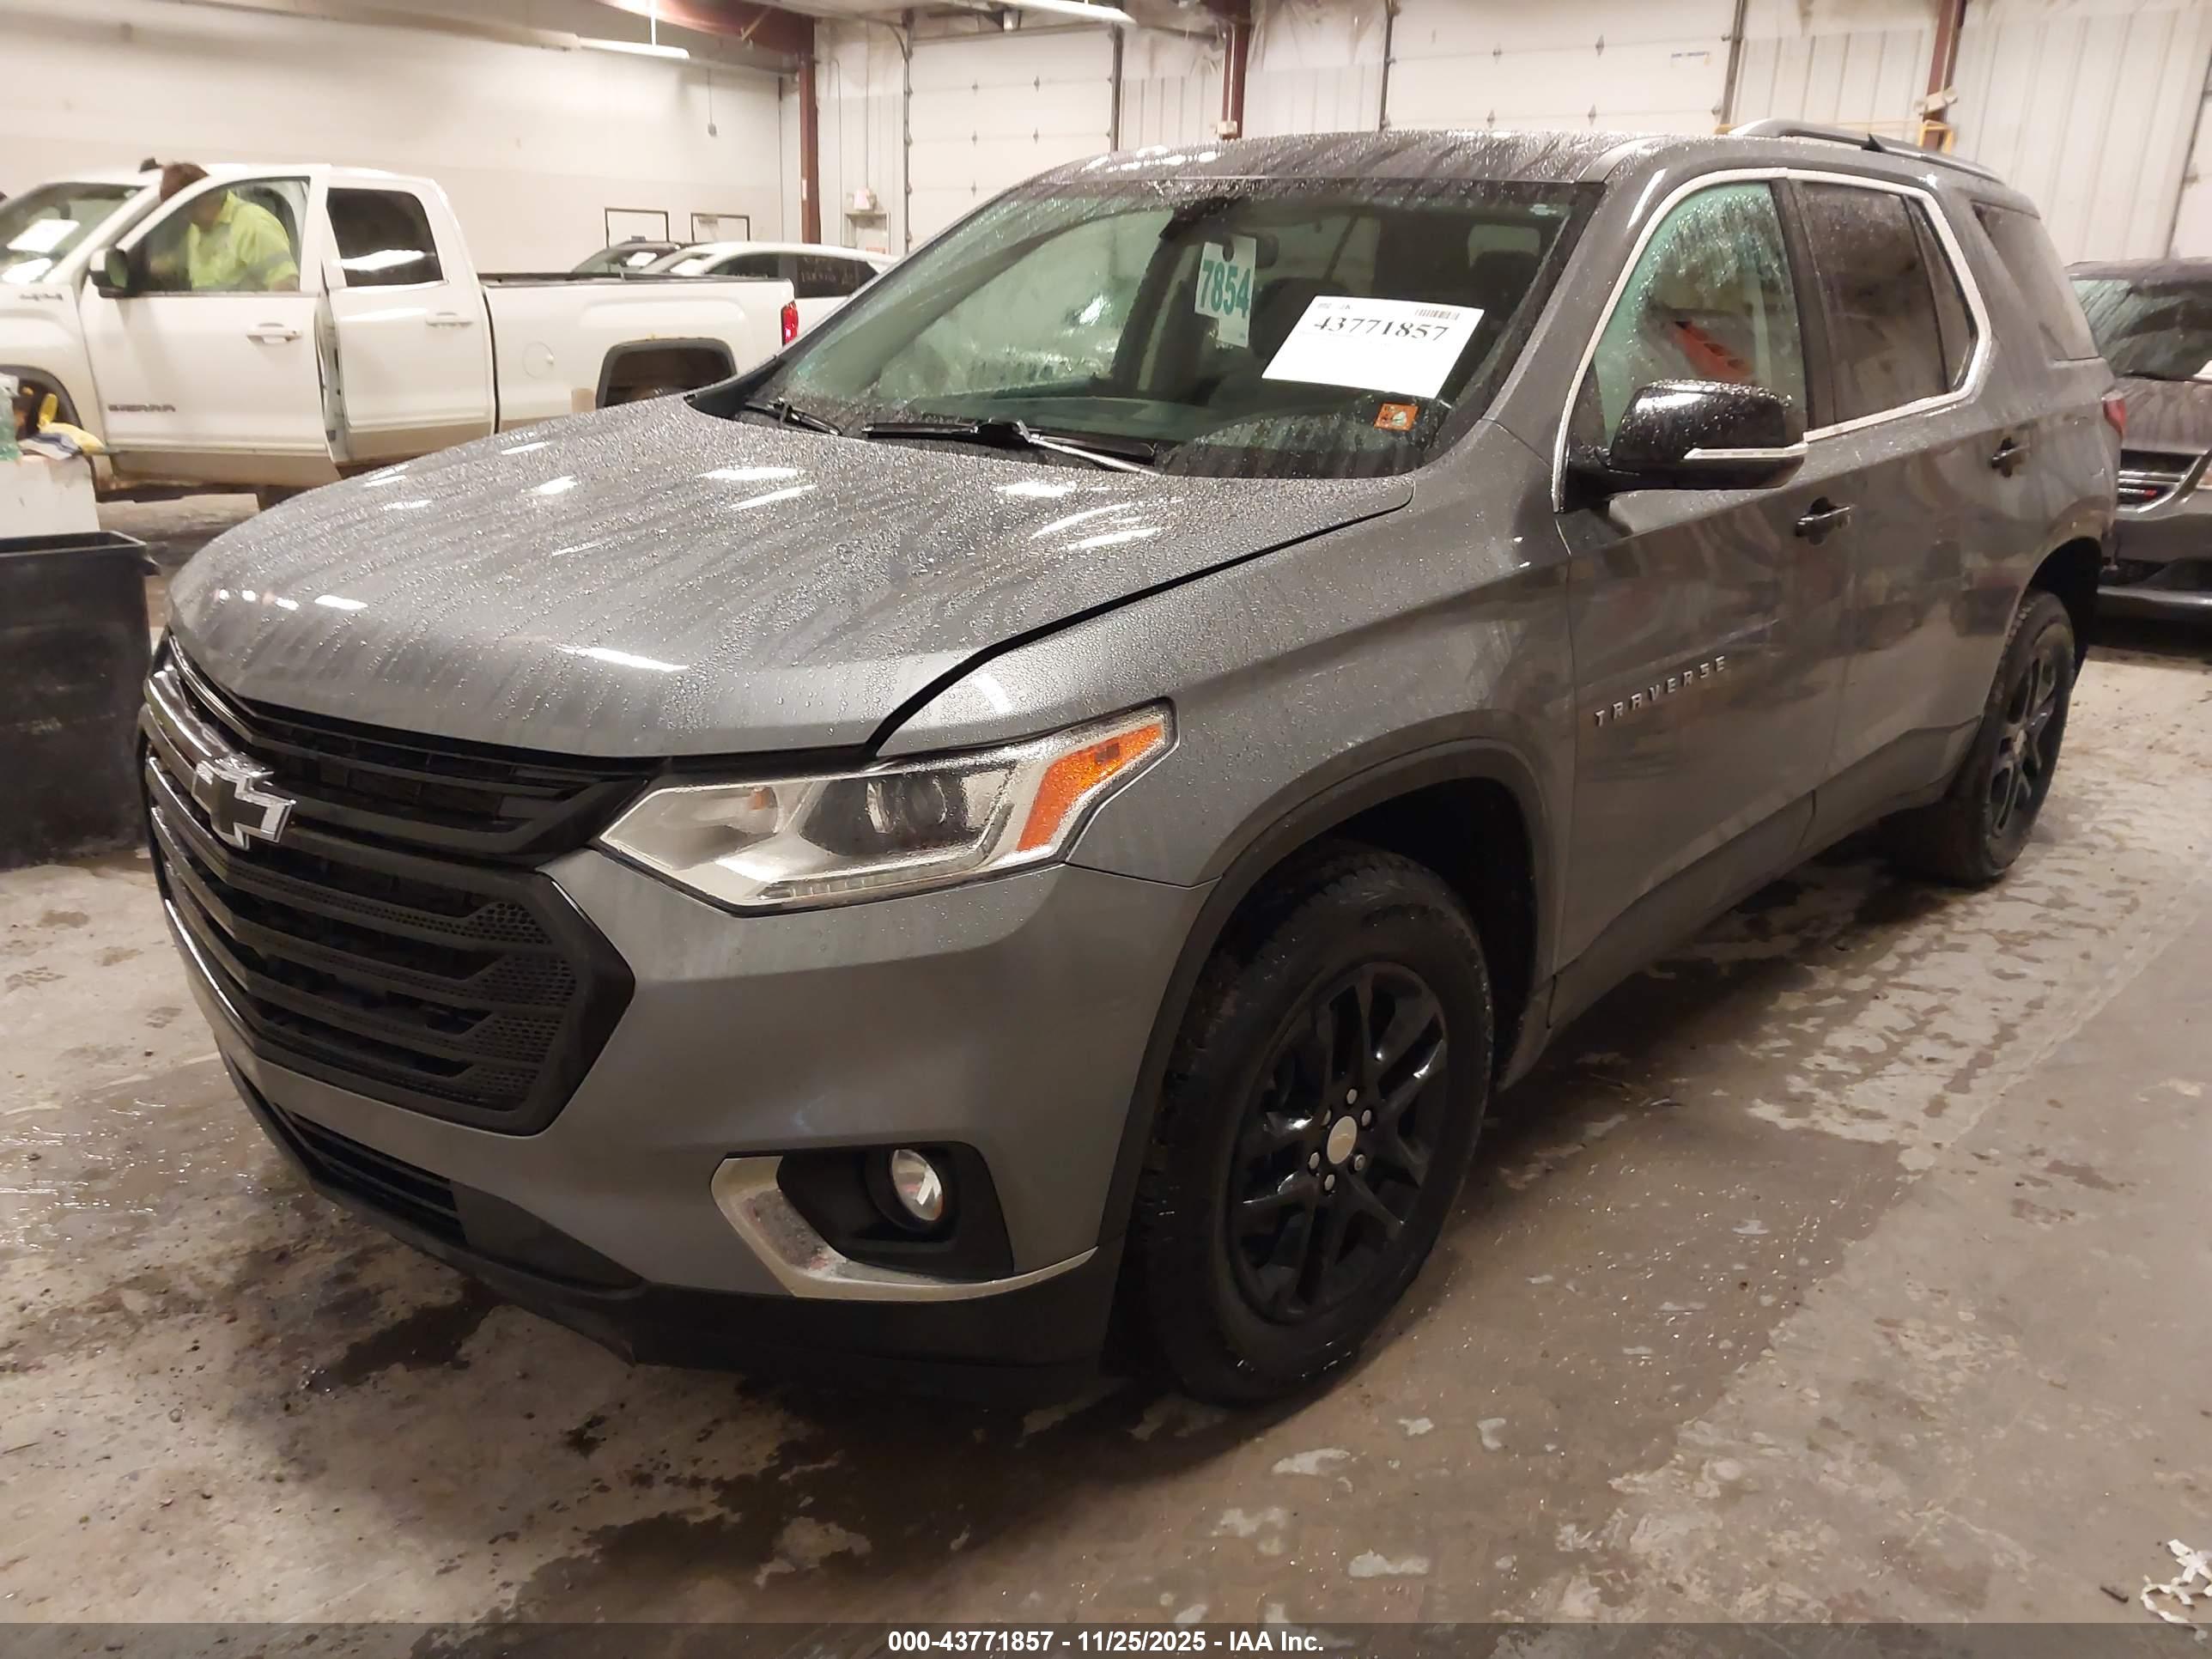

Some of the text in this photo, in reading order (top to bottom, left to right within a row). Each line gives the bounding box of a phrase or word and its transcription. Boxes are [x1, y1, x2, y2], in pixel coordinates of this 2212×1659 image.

[1200, 259, 1251, 319] 7854
[1314, 316, 1449, 341] 43771857
[1595, 655, 1725, 726] TRAVERSE
